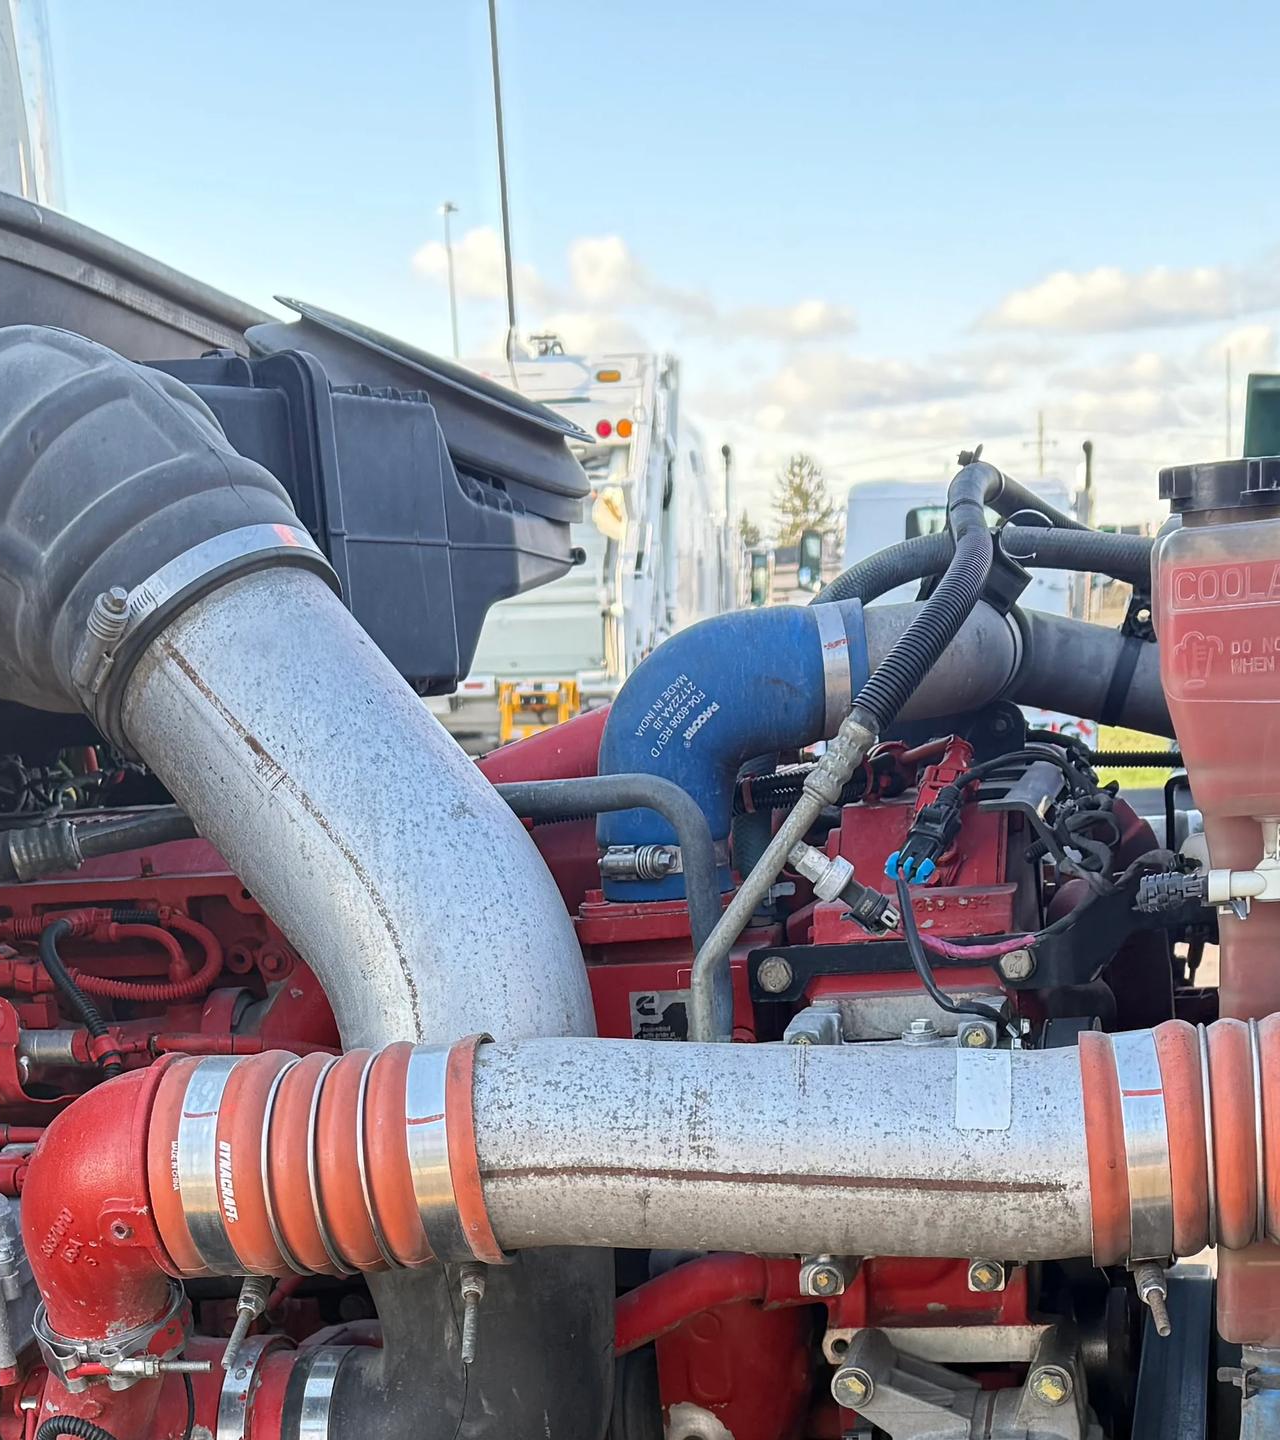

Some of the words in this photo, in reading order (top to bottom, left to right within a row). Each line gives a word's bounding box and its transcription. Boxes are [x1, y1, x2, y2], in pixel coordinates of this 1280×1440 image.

[1231, 639, 1251, 654] DO
[1231, 656, 1275, 673] WHEN
[661, 673, 688, 701] MADE
[652, 699, 664, 712] IN
[669, 690, 706, 728] F04-6006
[635, 710, 656, 737] INDIA
[652, 716, 664, 730] JB
[657, 727, 673, 750] REV
[651, 747, 660, 757] D
[219, 1140, 239, 1221] DYNACRAFT
